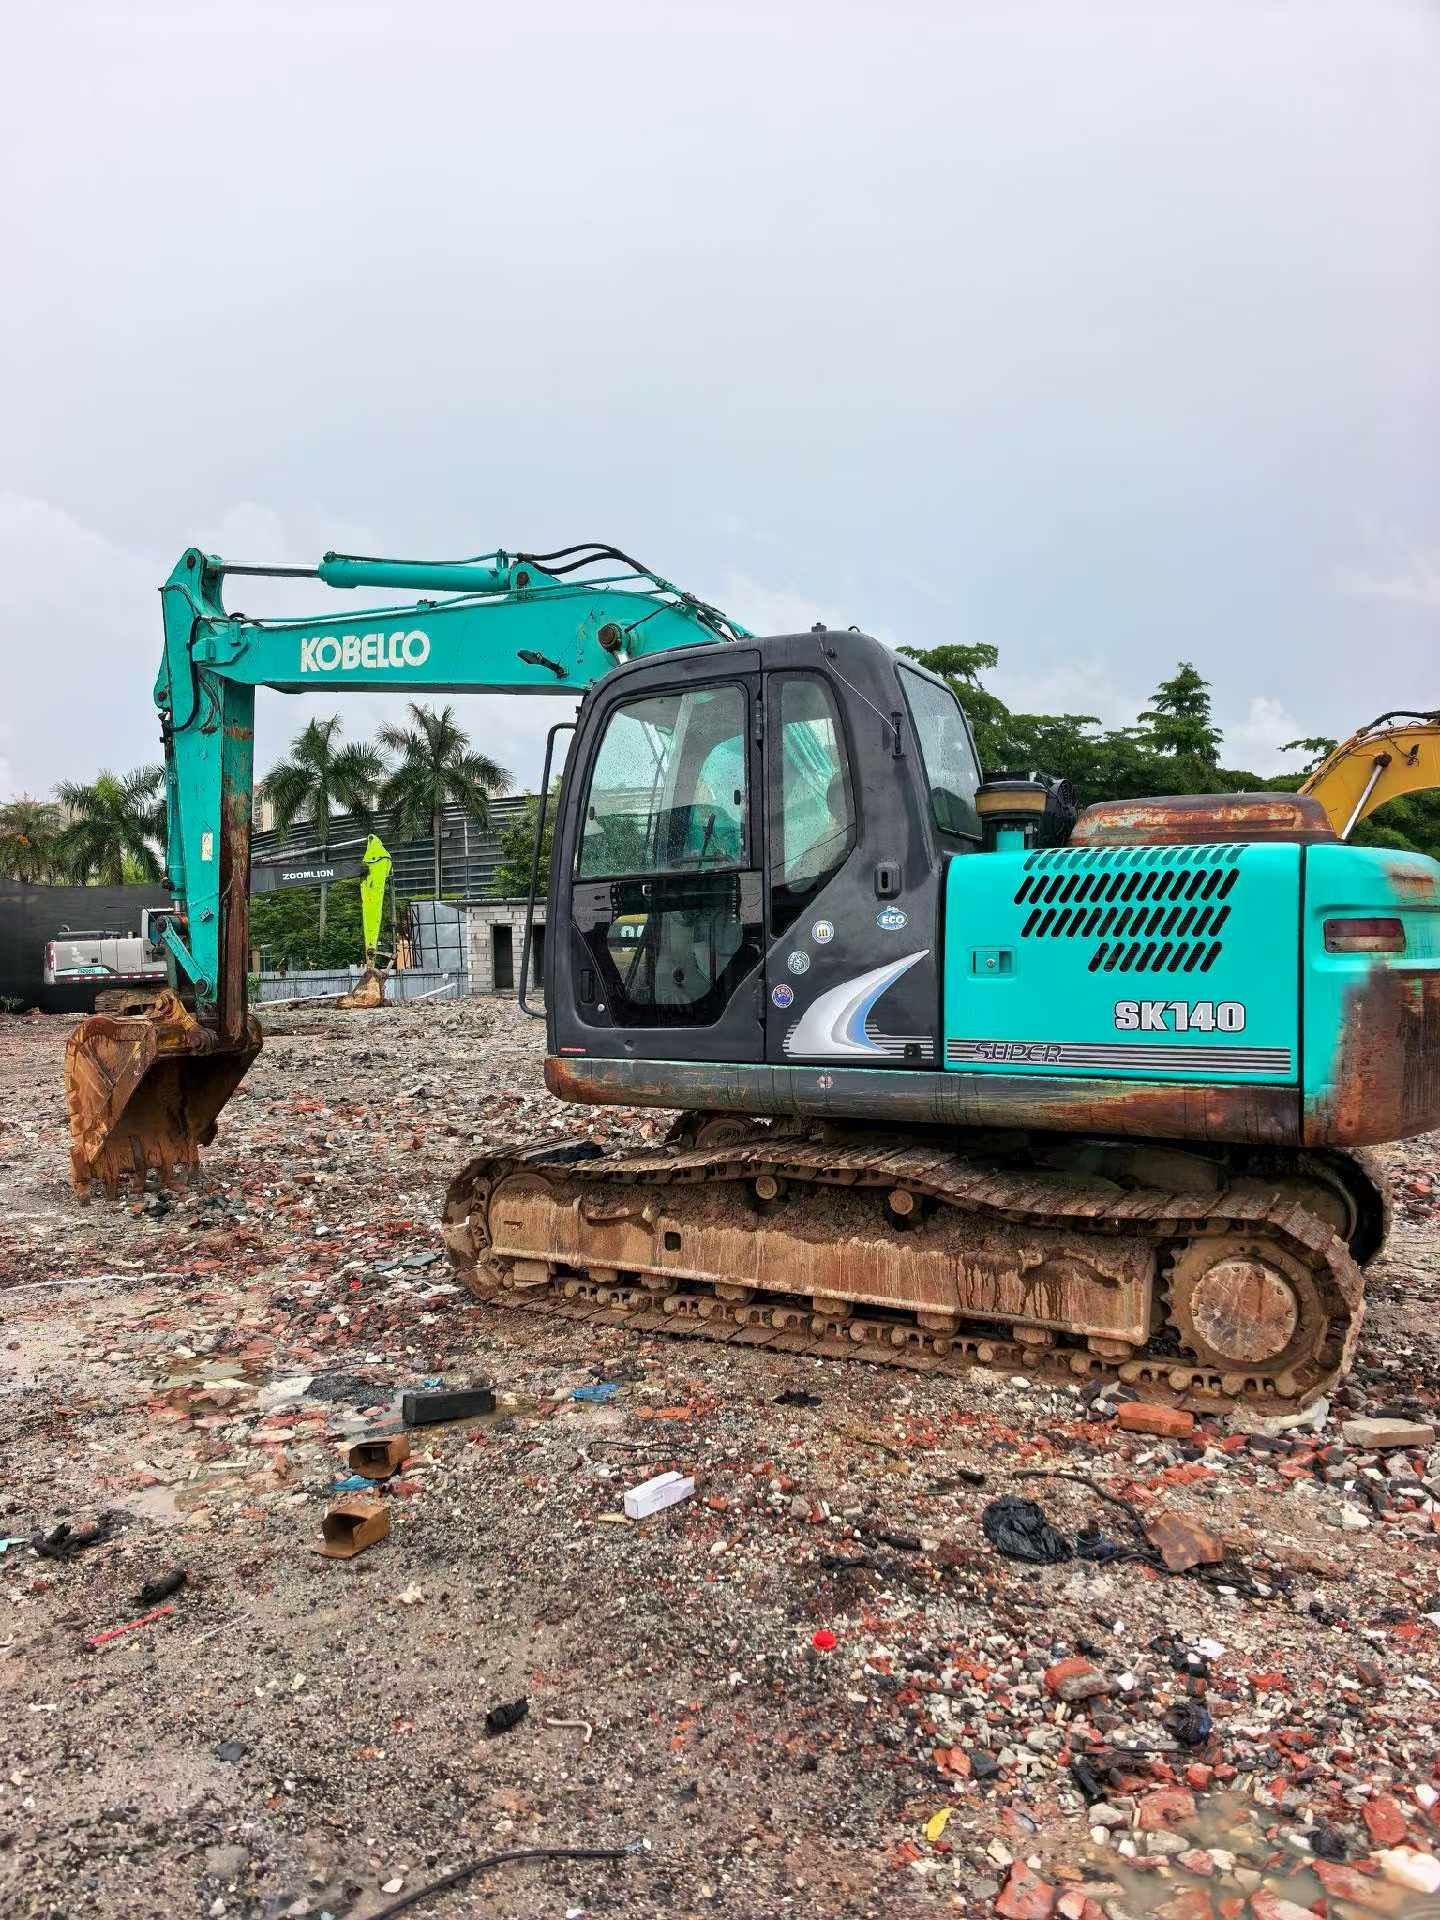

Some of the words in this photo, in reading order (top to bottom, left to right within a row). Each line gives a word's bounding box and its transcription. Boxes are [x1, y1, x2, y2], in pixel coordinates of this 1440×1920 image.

[301, 630, 430, 673] KOBELCO
[282, 869, 334, 881] ZOOMLION
[882, 914, 905, 924] ECO
[1114, 1000, 1246, 1033] SK140
[974, 1041, 1064, 1063] SUPER
